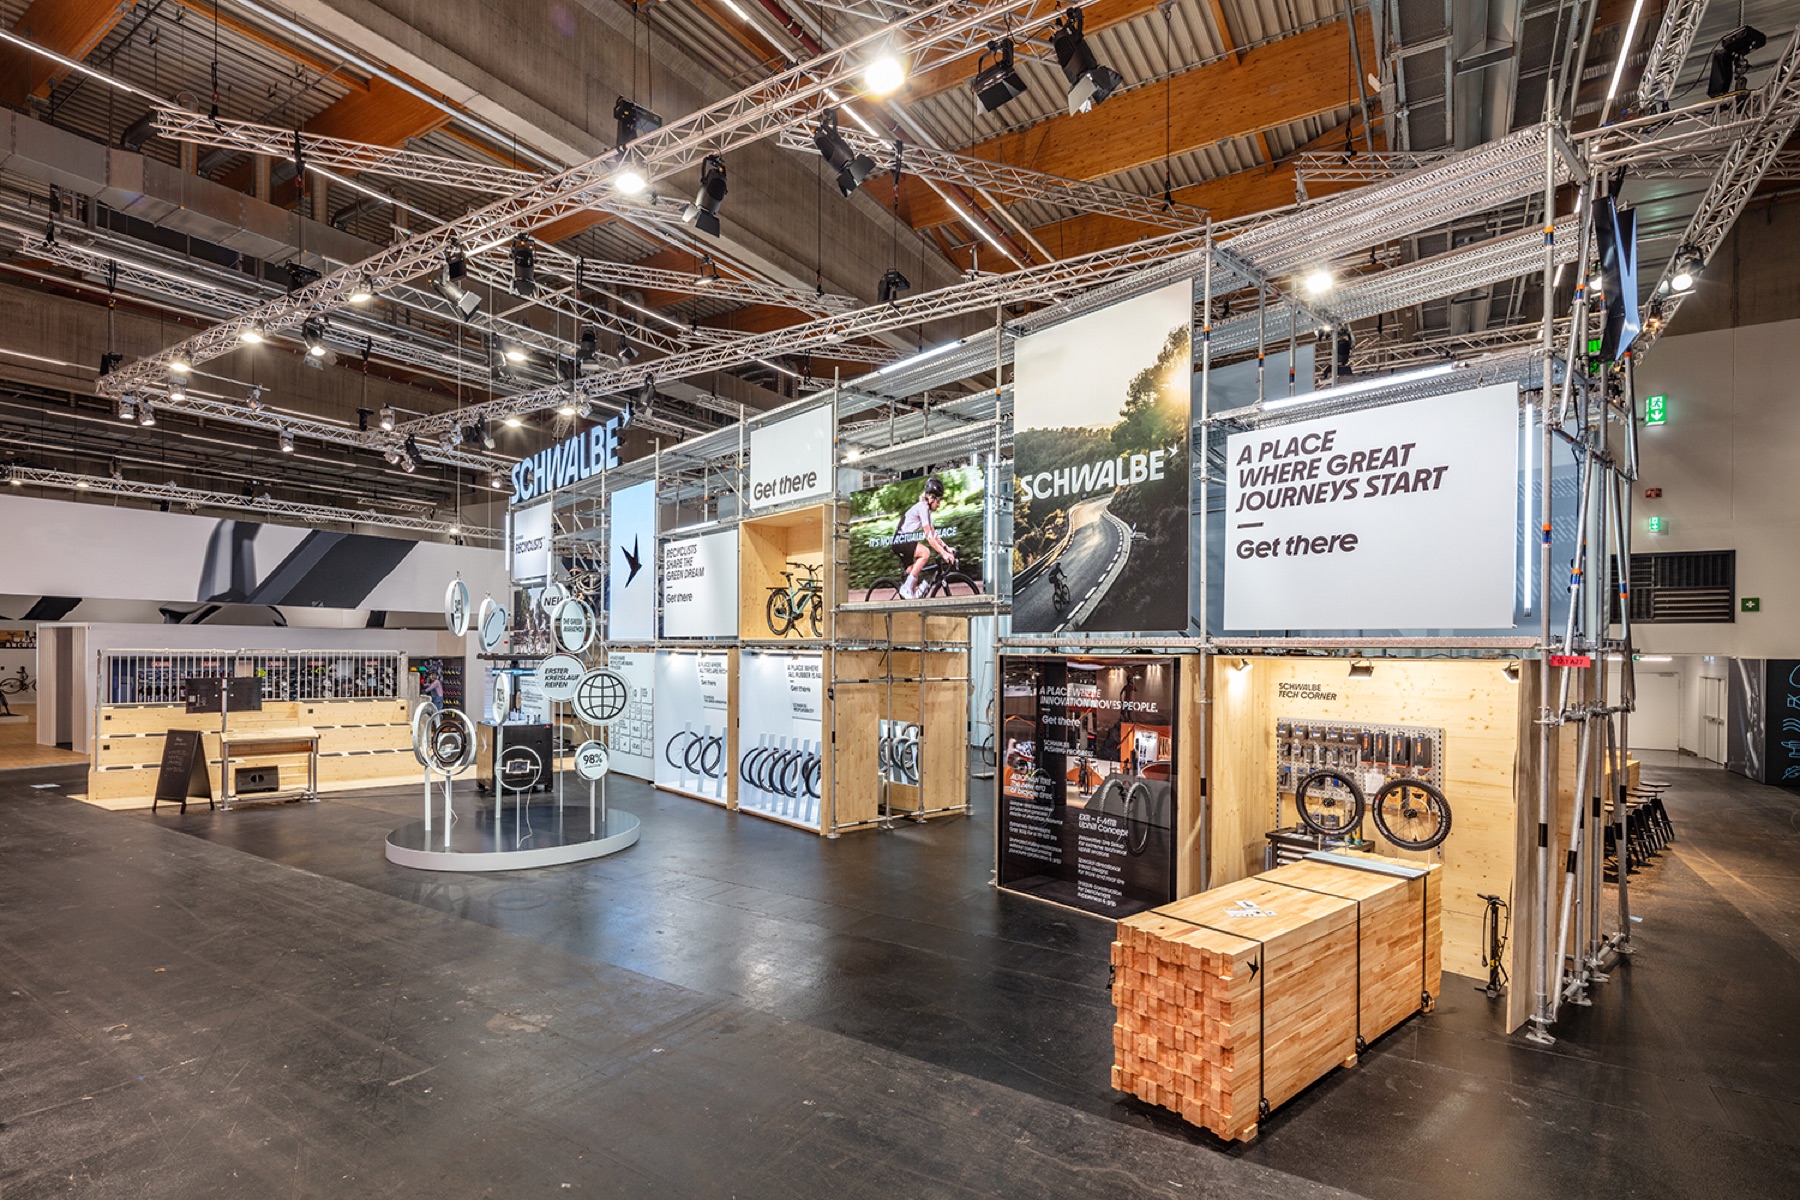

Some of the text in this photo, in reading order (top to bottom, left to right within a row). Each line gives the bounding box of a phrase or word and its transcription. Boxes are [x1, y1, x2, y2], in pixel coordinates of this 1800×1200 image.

[1236, 430, 1336, 466] A PLACE
[511, 420, 620, 503] SCHWALBE
[1240, 442, 1416, 488] WHERE GREAT
[1021, 450, 1165, 502] SCHWALBE
[754, 470, 817, 501] Get there
[1236, 466, 1448, 512] JOURNEYS START
[881, 536, 893, 546] NOT
[935, 526, 957, 539] PLACE
[1236, 533, 1358, 558] Get there
[666, 557, 694, 570] SHARE THE
[666, 566, 704, 581] GREEN DREAM
[666, 593, 692, 603] Get there
[1039, 686, 1045, 695] A
[1046, 687, 1071, 696] PLACE
[1278, 682, 1321, 691] SCHWALBE
[1301, 691, 1337, 701] CORNER
[1040, 696, 1090, 707] INNOVATION
[1122, 701, 1158, 713] PEOPLE.
[1042, 715, 1080, 727] Get there
[583, 754, 602, 764] 98%
[1098, 824, 1128, 836] Concept
